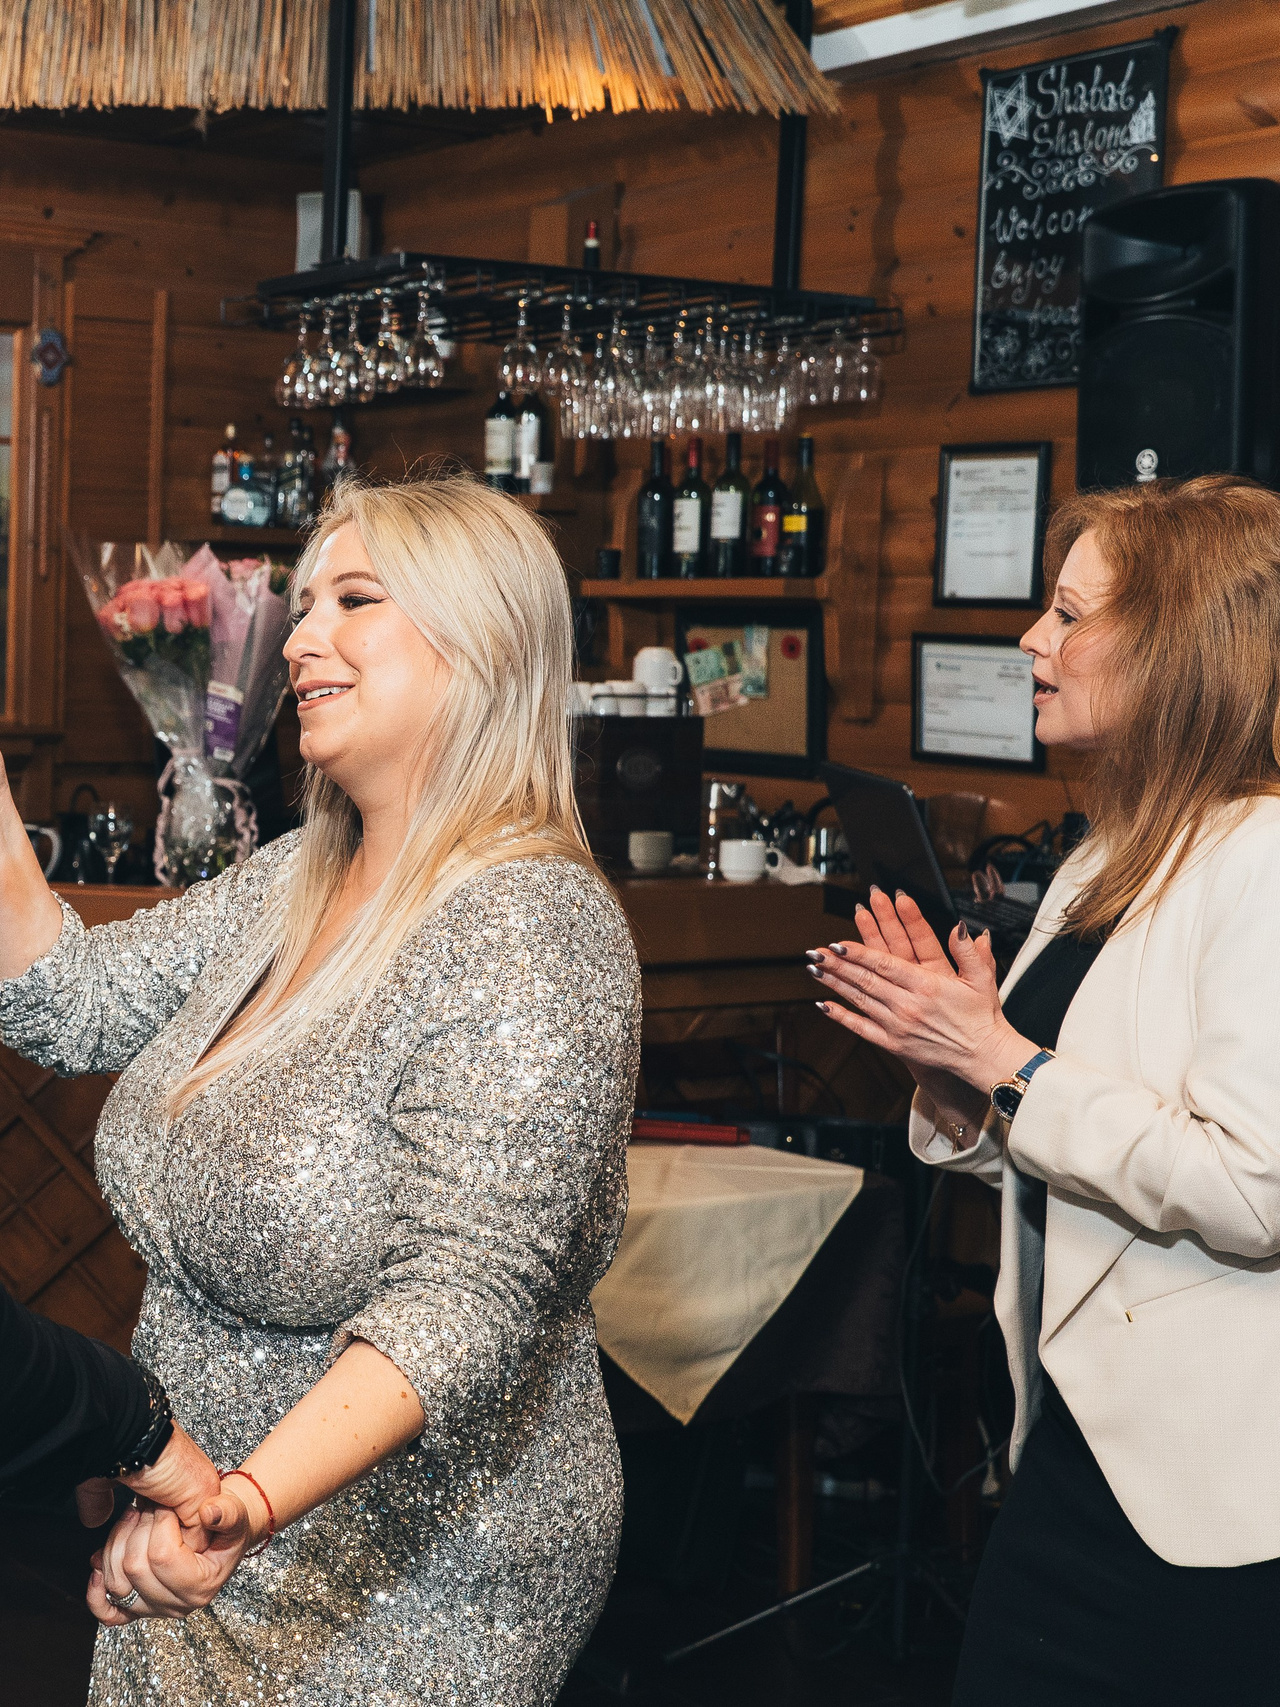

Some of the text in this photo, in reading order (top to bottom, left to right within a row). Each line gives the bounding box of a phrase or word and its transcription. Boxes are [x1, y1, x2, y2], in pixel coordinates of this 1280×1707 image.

[1036, 60, 1135, 119] Shabat
[1029, 120, 1132, 158] Shalom
[990, 249, 1065, 304] Enjoy
